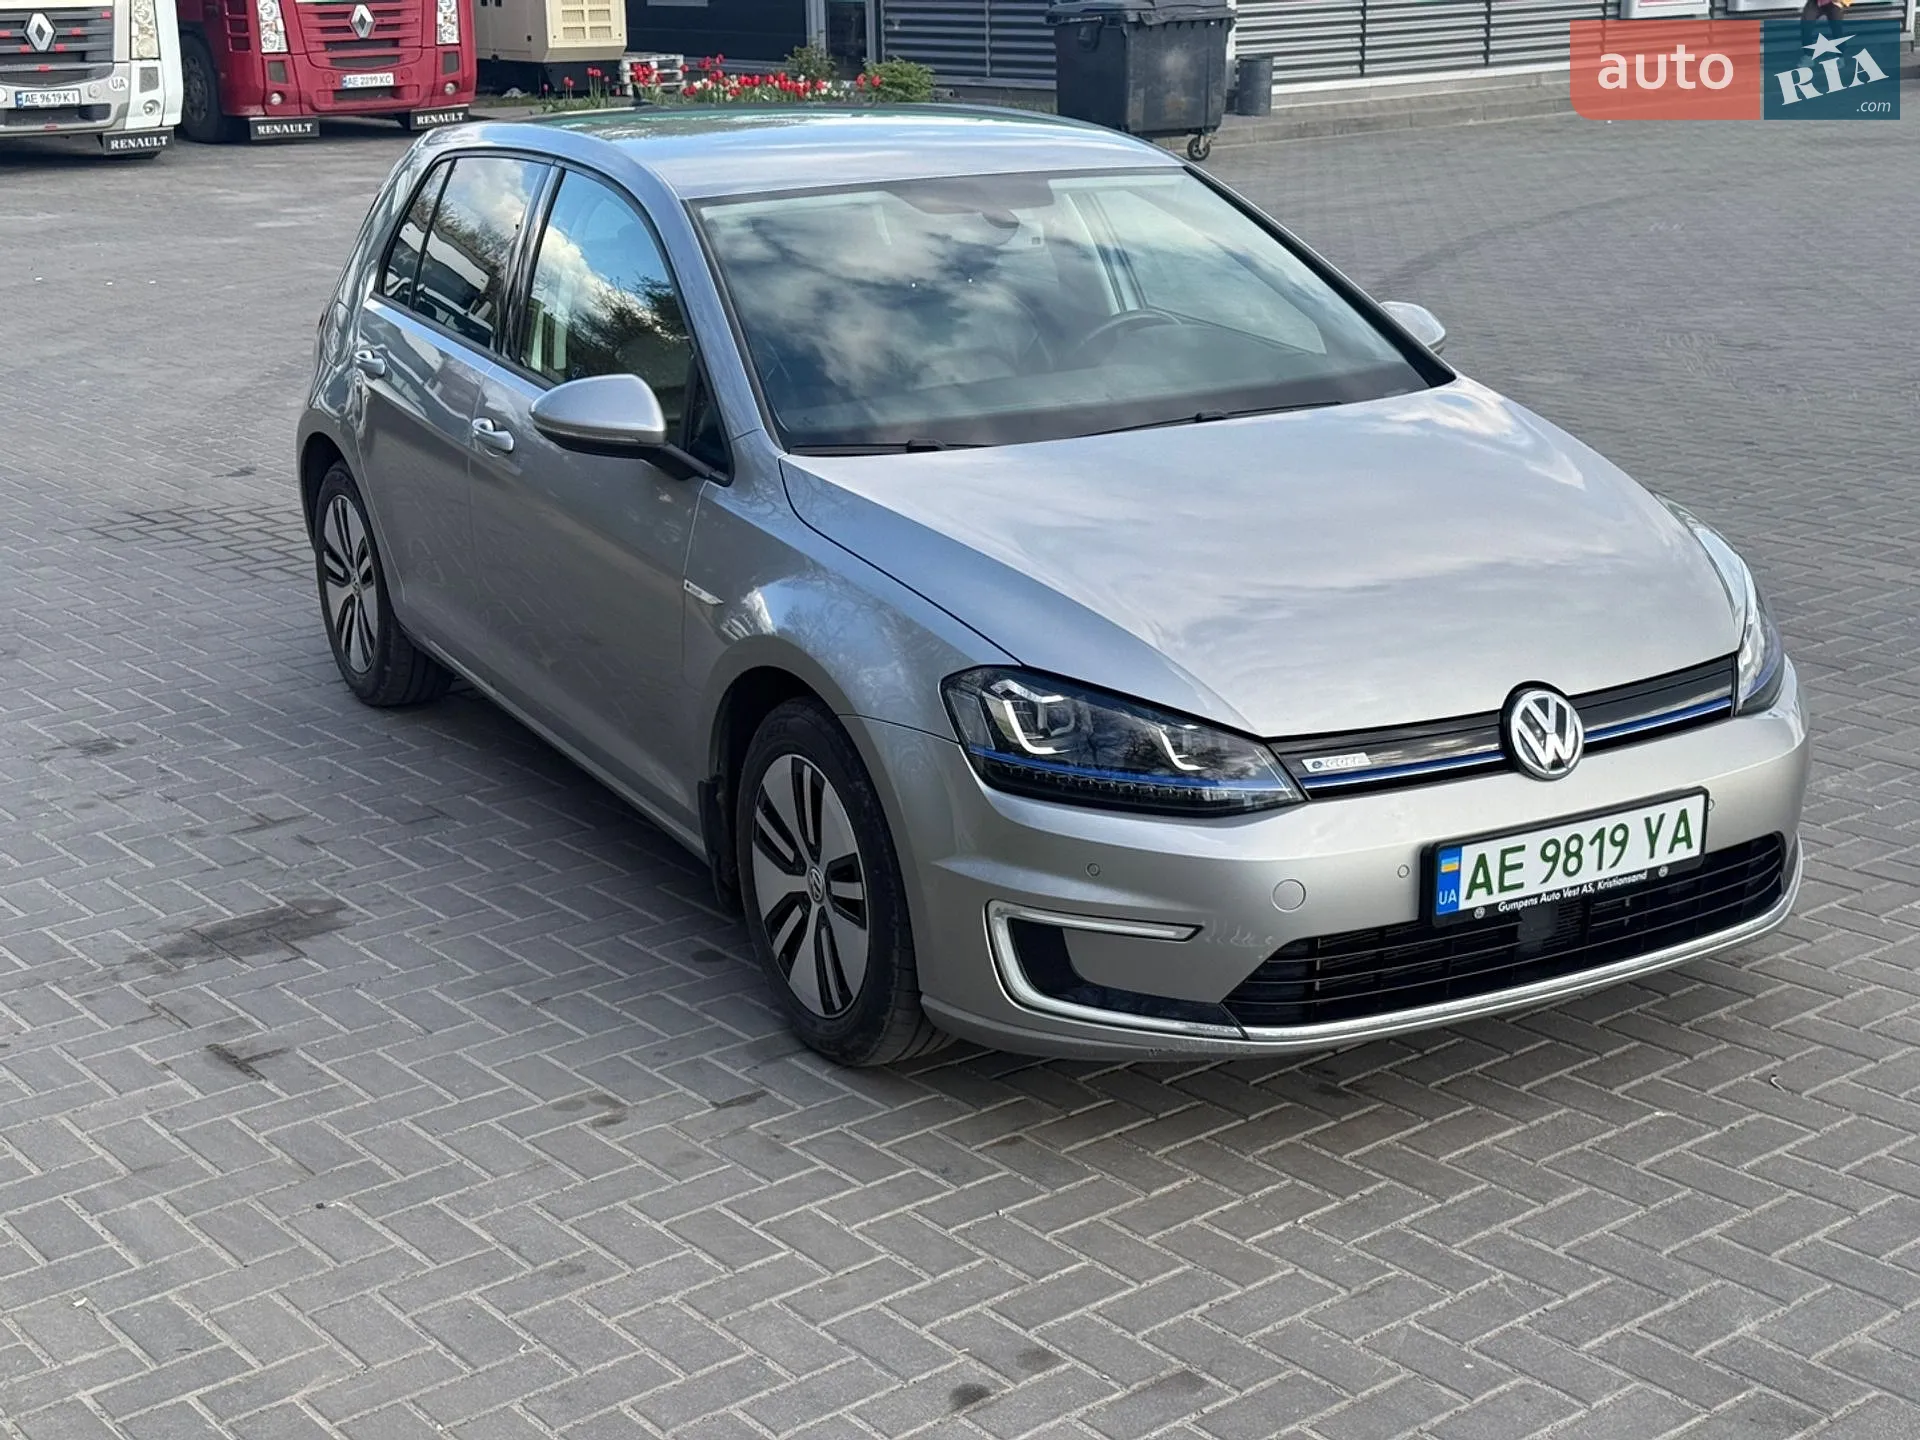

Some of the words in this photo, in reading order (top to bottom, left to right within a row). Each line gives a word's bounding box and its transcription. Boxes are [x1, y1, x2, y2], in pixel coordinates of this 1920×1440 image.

[111, 78, 126, 89] UA
[25, 93, 39, 104] AE
[417, 112, 465, 125] RENAULT
[257, 123, 313, 135] RENAULT
[110, 135, 168, 150] RENAULT
[1465, 844, 1526, 900] AE
[1540, 823, 1629, 885] 9819
[1644, 808, 1693, 859] YA
[1438, 889, 1457, 905] UA
[1498, 897, 1538, 912] Gumpens
[1539, 891, 1560, 904] Auto
[1562, 886, 1580, 899] Vest
[1581, 882, 1595, 895] AS,
